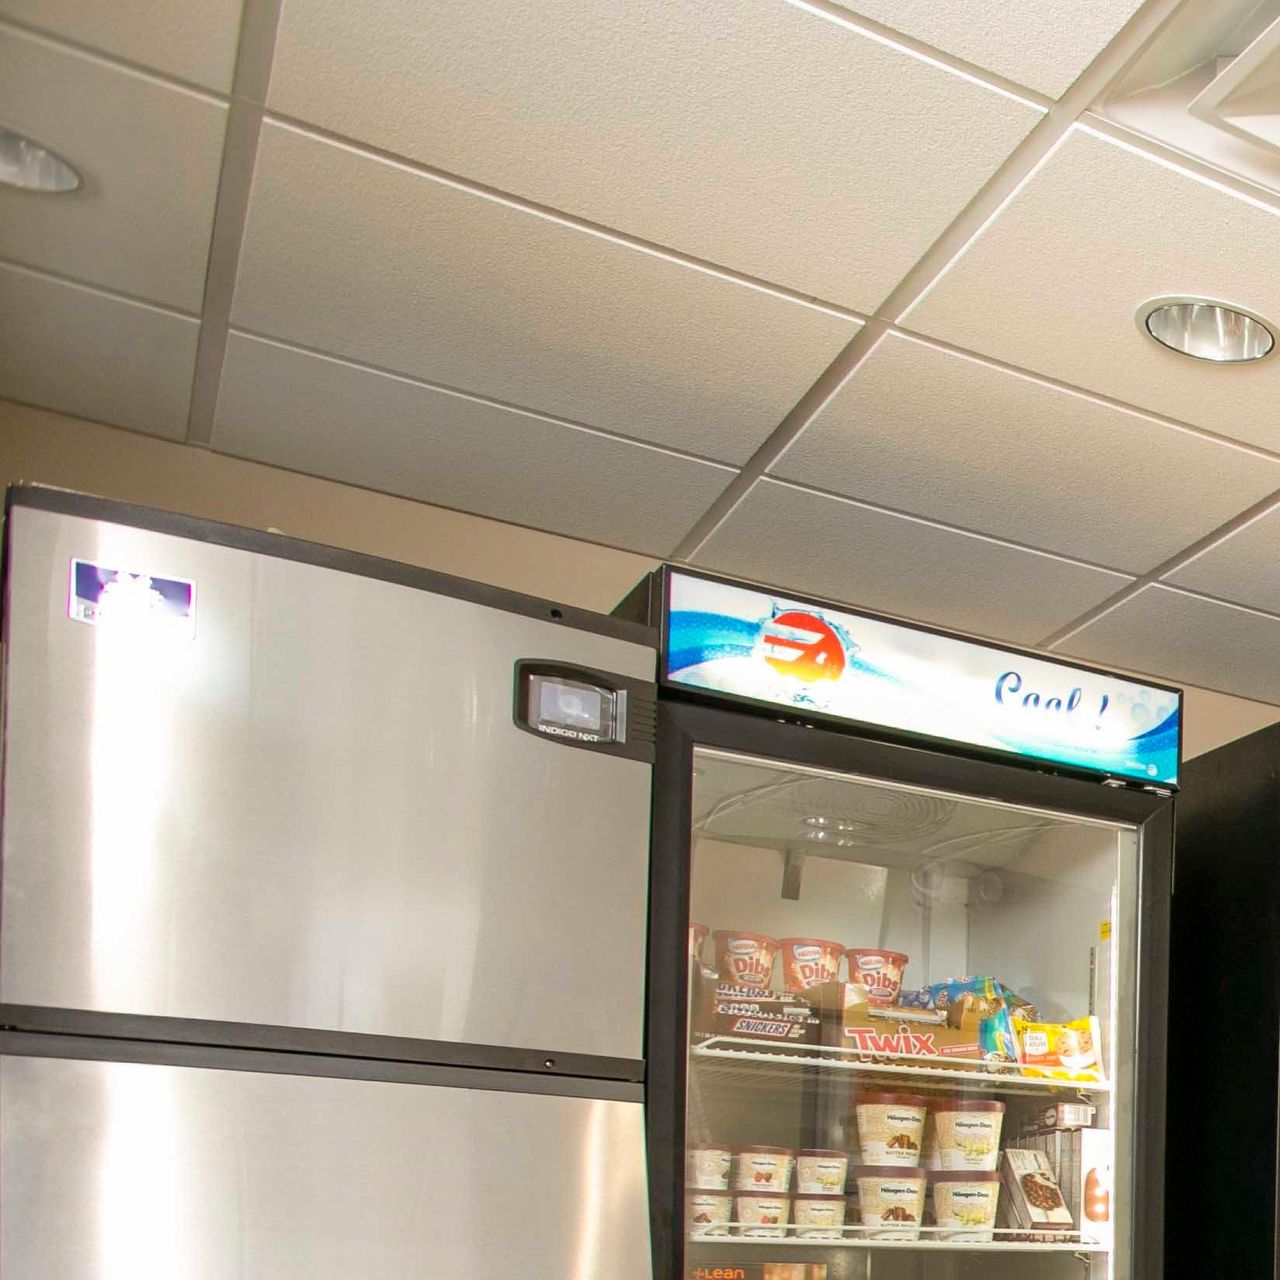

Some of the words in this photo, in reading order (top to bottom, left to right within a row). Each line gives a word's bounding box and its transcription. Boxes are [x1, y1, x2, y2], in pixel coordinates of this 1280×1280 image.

[733, 957, 771, 977] Dibs
[863, 972, 898, 991] Dibs
[735, 1020, 789, 1036] SNICKERS
[705, 1268, 745, 1280] Lean
